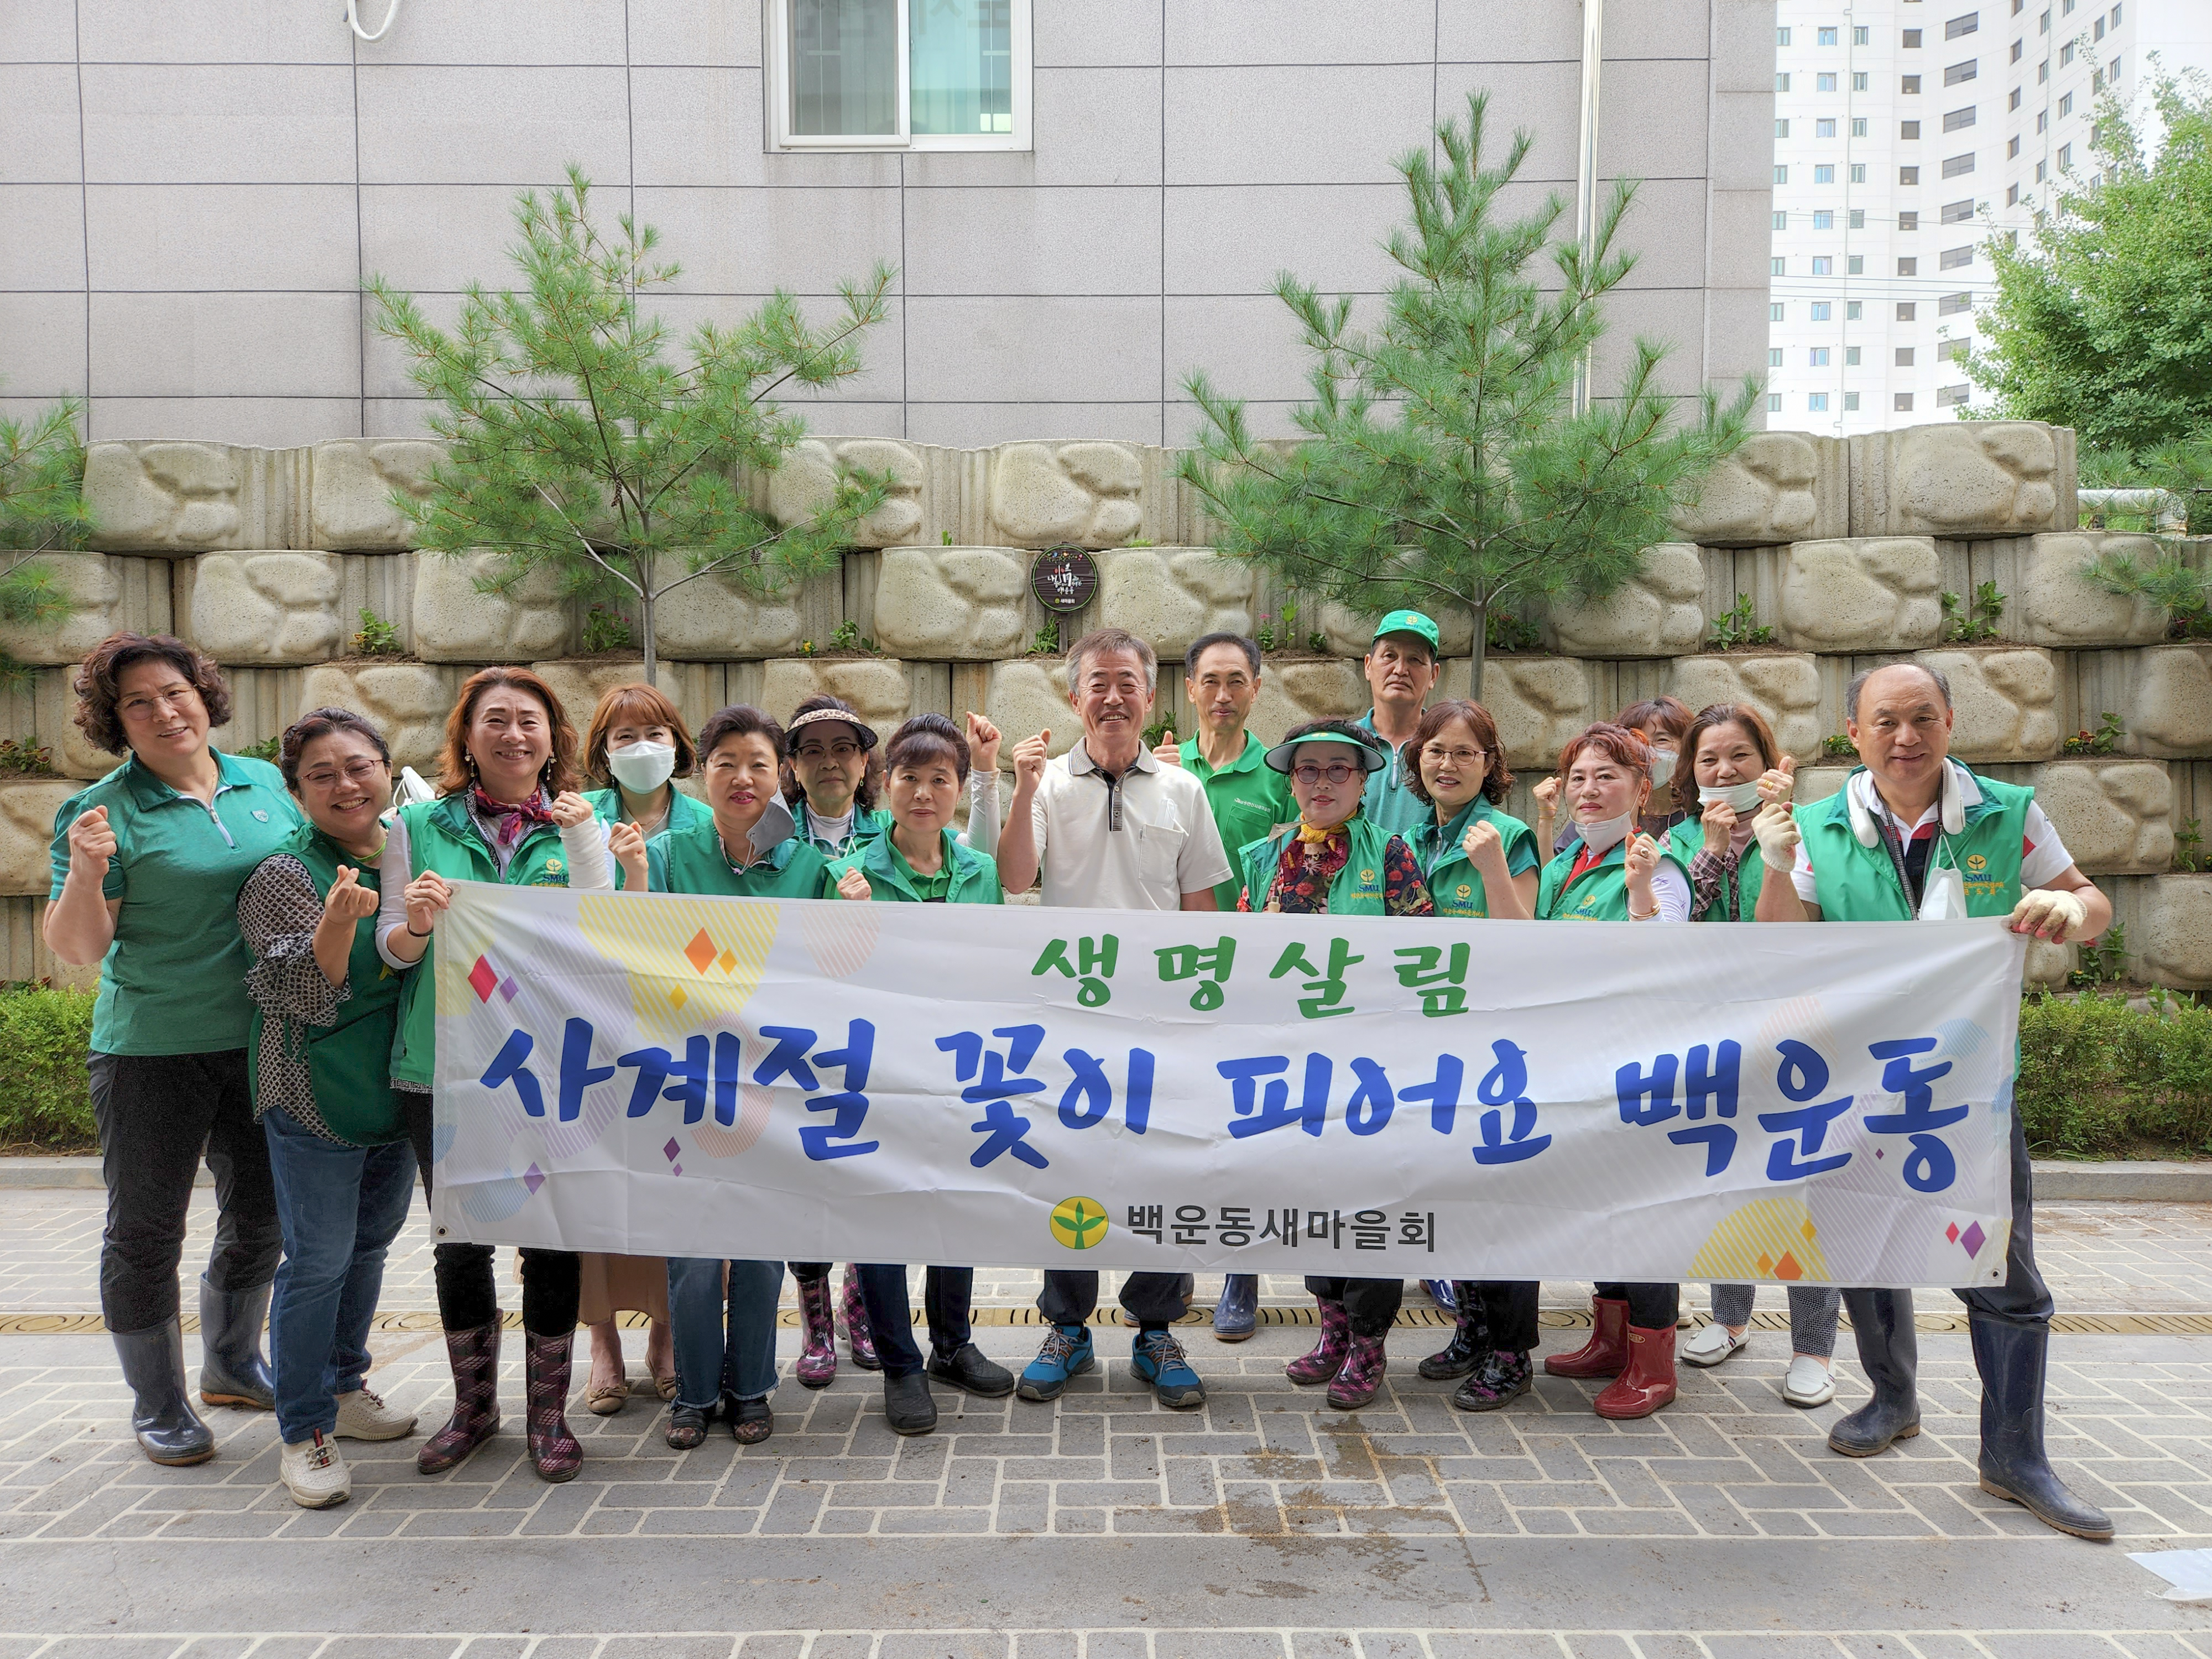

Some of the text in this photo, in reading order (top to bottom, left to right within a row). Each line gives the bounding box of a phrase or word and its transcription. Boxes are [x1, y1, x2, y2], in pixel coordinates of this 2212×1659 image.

[543, 874, 565, 882] SMU
[1965, 874, 1992, 882] SMU
[1452, 900, 1473, 909] SMU
[480, 1018, 1968, 1192] 사계절 꽃이 피어요 백운동
[1128, 1206, 1433, 1252] 백운동새마을회
